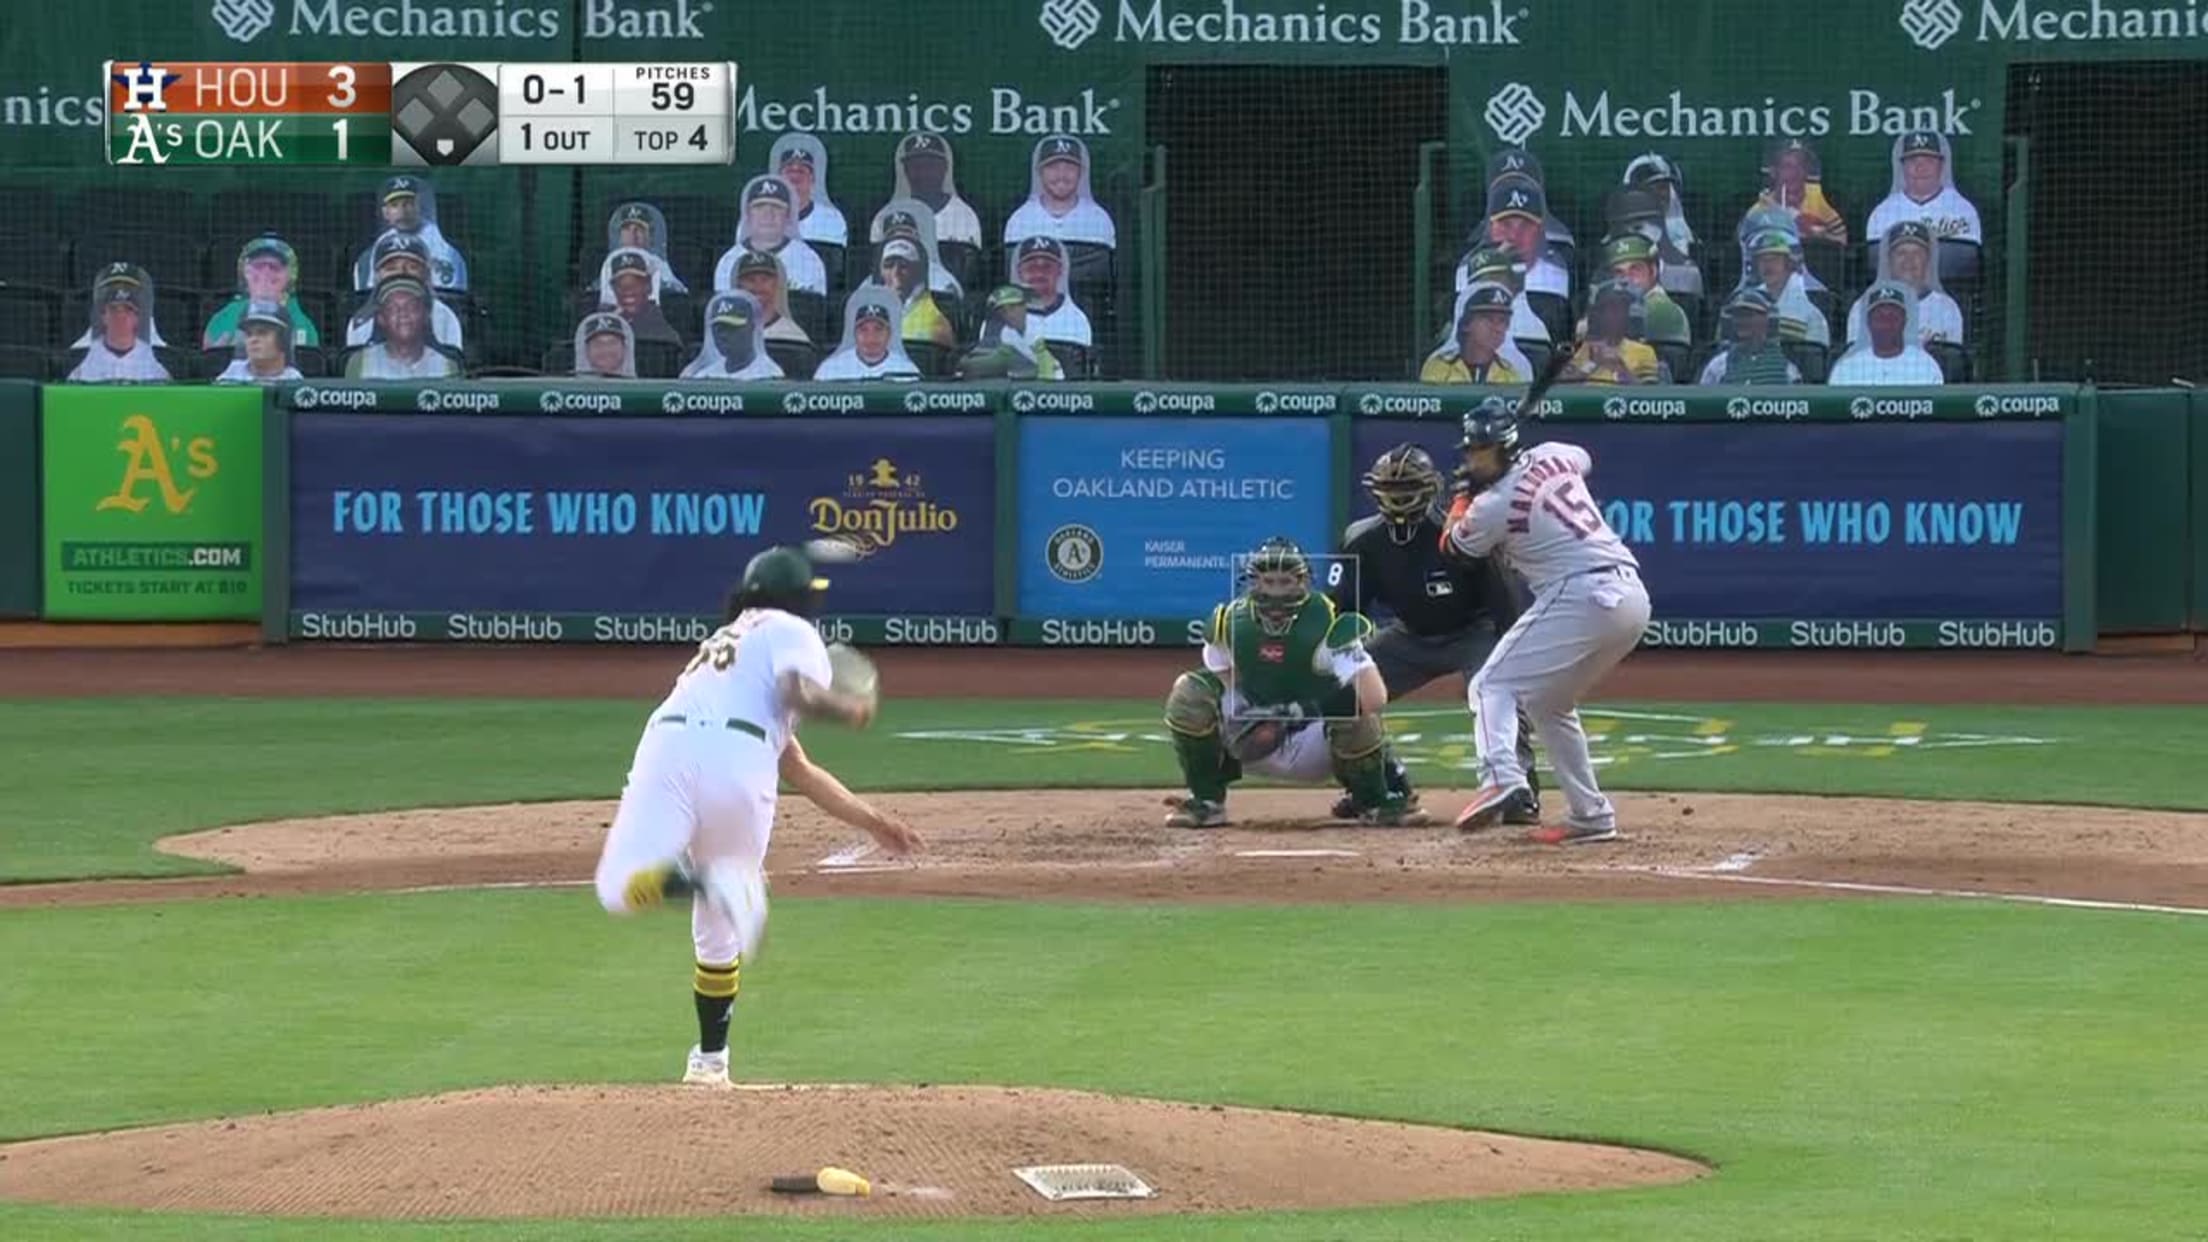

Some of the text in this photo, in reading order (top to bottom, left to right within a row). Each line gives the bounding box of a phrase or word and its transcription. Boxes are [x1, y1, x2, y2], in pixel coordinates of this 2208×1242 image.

[289, 0, 704, 38] Mechanics Bank
[1113, 0, 1520, 44] Mechanics Bank
[989, 87, 1111, 135] Bank
[1560, 89, 1973, 138] Mechanics Bank
[319, 387, 377, 408] coupa
[442, 390, 500, 412] coupa
[564, 391, 622, 412] coupa
[686, 391, 744, 412] coupa
[808, 391, 865, 412] coupa
[928, 390, 985, 411] coupa
[1036, 390, 1094, 411] coupa
[1158, 391, 1215, 412] coupa
[1278, 390, 1336, 412] coupa
[1384, 394, 1442, 415] coupa
[1628, 396, 1686, 417] coupa
[1751, 396, 1809, 418] coupa
[1876, 396, 1934, 418] coupa
[2000, 394, 2059, 416] coupa
[1120, 449, 1226, 470] KEEPING
[1052, 477, 1295, 500] OAKLAND ATHLETIC
[333, 490, 766, 536] FOR THOSE WHO KNOW
[1542, 480, 1602, 540] 15
[1603, 501, 2024, 545] OR THOSE WHO KNOW
[1144, 540, 1186, 552] KAISER
[1327, 562, 1344, 587] 8
[68, 580, 136, 595] TICKETS
[139, 580, 190, 595] START
[302, 613, 416, 639] StubHub
[448, 614, 563, 641] StubHub
[594, 616, 707, 642] StubHub
[884, 617, 998, 643] StubHub
[1041, 619, 1156, 645] StubHub
[1643, 621, 1758, 647] StubHub
[1790, 621, 1906, 647] StubHub
[1937, 620, 2056, 647] StubHub
